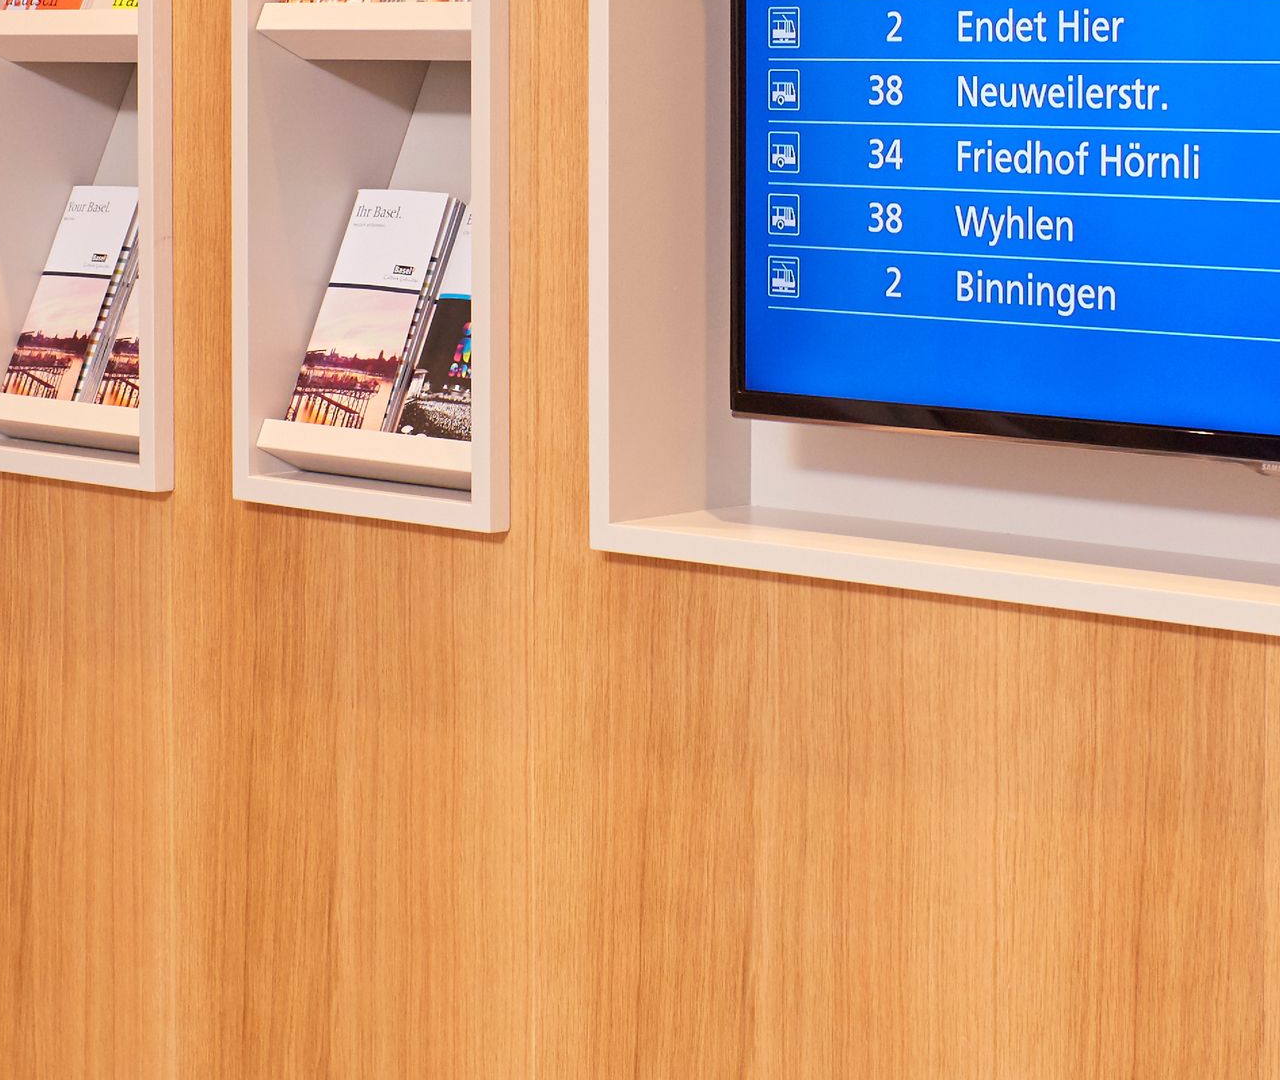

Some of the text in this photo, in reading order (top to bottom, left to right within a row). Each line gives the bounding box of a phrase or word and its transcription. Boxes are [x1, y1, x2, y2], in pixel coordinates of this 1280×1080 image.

[886, 11, 903, 42] 2
[958, 7, 1047, 42] Endet
[1058, 8, 1125, 43] Hier
[868, 74, 904, 106] 38
[957, 74, 1168, 111] Neuweilerstr.
[868, 138, 904, 170] 34
[957, 139, 1090, 176] Friedhof
[1100, 142, 1200, 180] Hörnli
[87, 201, 111, 213] Basel.
[356, 205, 402, 219] Ihr Basel.
[868, 202, 903, 234] 38
[955, 205, 1074, 247] Wyhlen
[885, 266, 902, 298] 2
[955, 270, 1116, 317] Binningen
